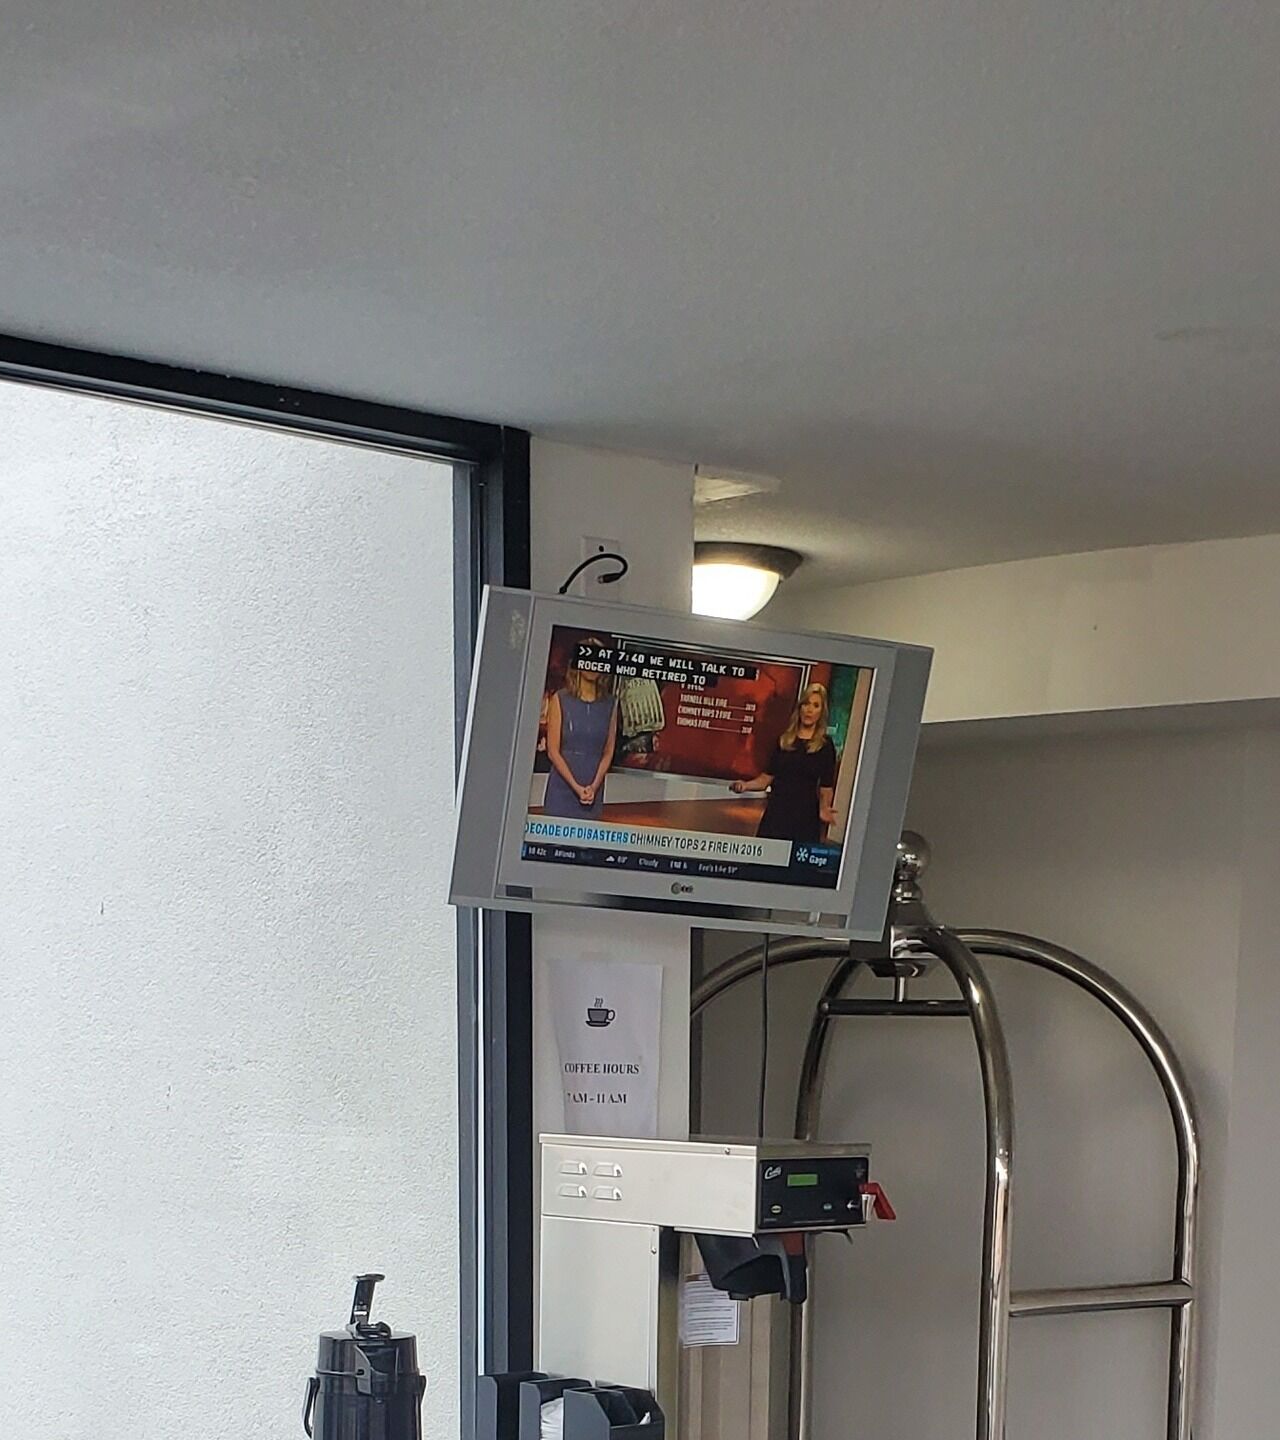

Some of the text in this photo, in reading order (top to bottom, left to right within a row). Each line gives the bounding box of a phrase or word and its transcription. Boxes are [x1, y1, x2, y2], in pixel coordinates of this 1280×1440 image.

[577, 659, 611, 673] ROGER
[616, 664, 636, 676] WHO
[642, 668, 687, 683] RETIRED
[693, 674, 706, 685] TO
[598, 649, 613, 660] AT
[618, 651, 645, 664] 7:40
[650, 655, 663, 666] WE
[669, 658, 694, 670] WILL
[701, 662, 726, 675] TALK
[732, 667, 745, 677] TO
[562, 826, 576, 838] OF
[577, 827, 629, 844] DISASTERS
[630, 833, 673, 848] CHIMNEY
[675, 837, 699, 851] TOPS
[701, 840, 707, 851] 2
[708, 841, 727, 853] FIRE
[729, 843, 739, 854] IN
[741, 844, 763, 857] 2016
[564, 1062, 640, 1074] COFFEE HOURS
